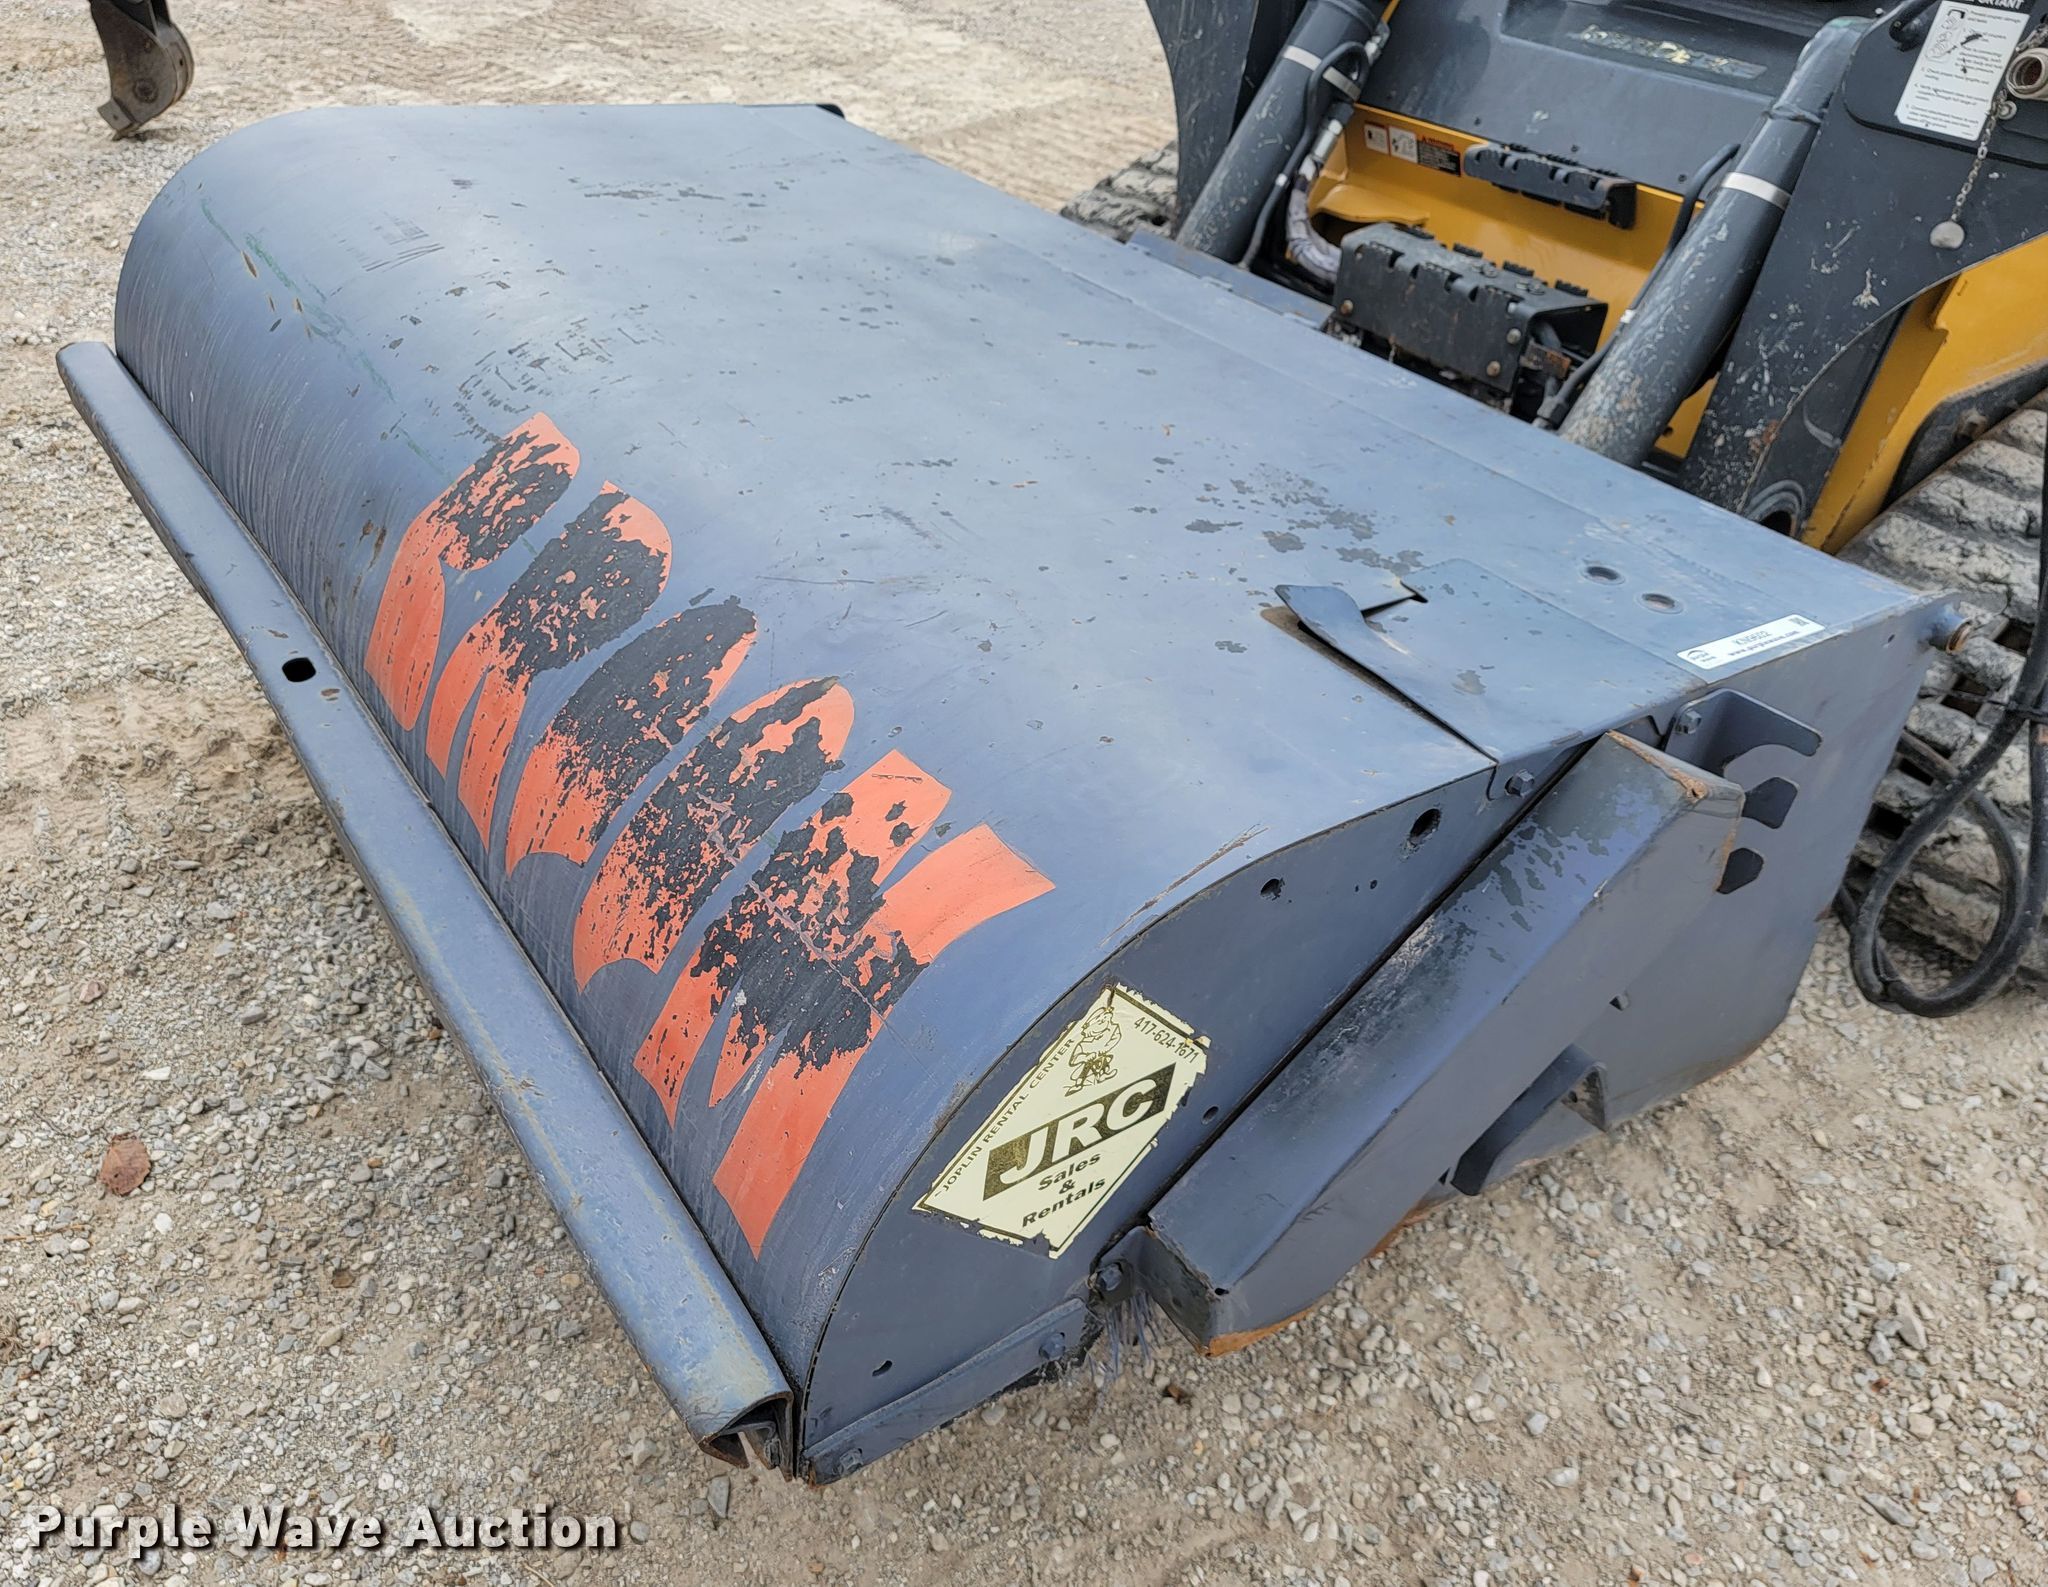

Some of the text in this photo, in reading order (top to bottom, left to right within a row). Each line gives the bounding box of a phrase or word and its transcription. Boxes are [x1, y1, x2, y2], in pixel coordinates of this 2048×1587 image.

[1134, 1015, 1199, 1064] 417-624-1671
[941, 1037, 1075, 1193] JOPLIN RENTAL CENTER
[999, 1078, 1159, 1186] JRC
[1038, 1153, 1101, 1191] Sales
[1058, 1180, 1076, 1195] &
[1021, 1177, 1106, 1228] Rentals
